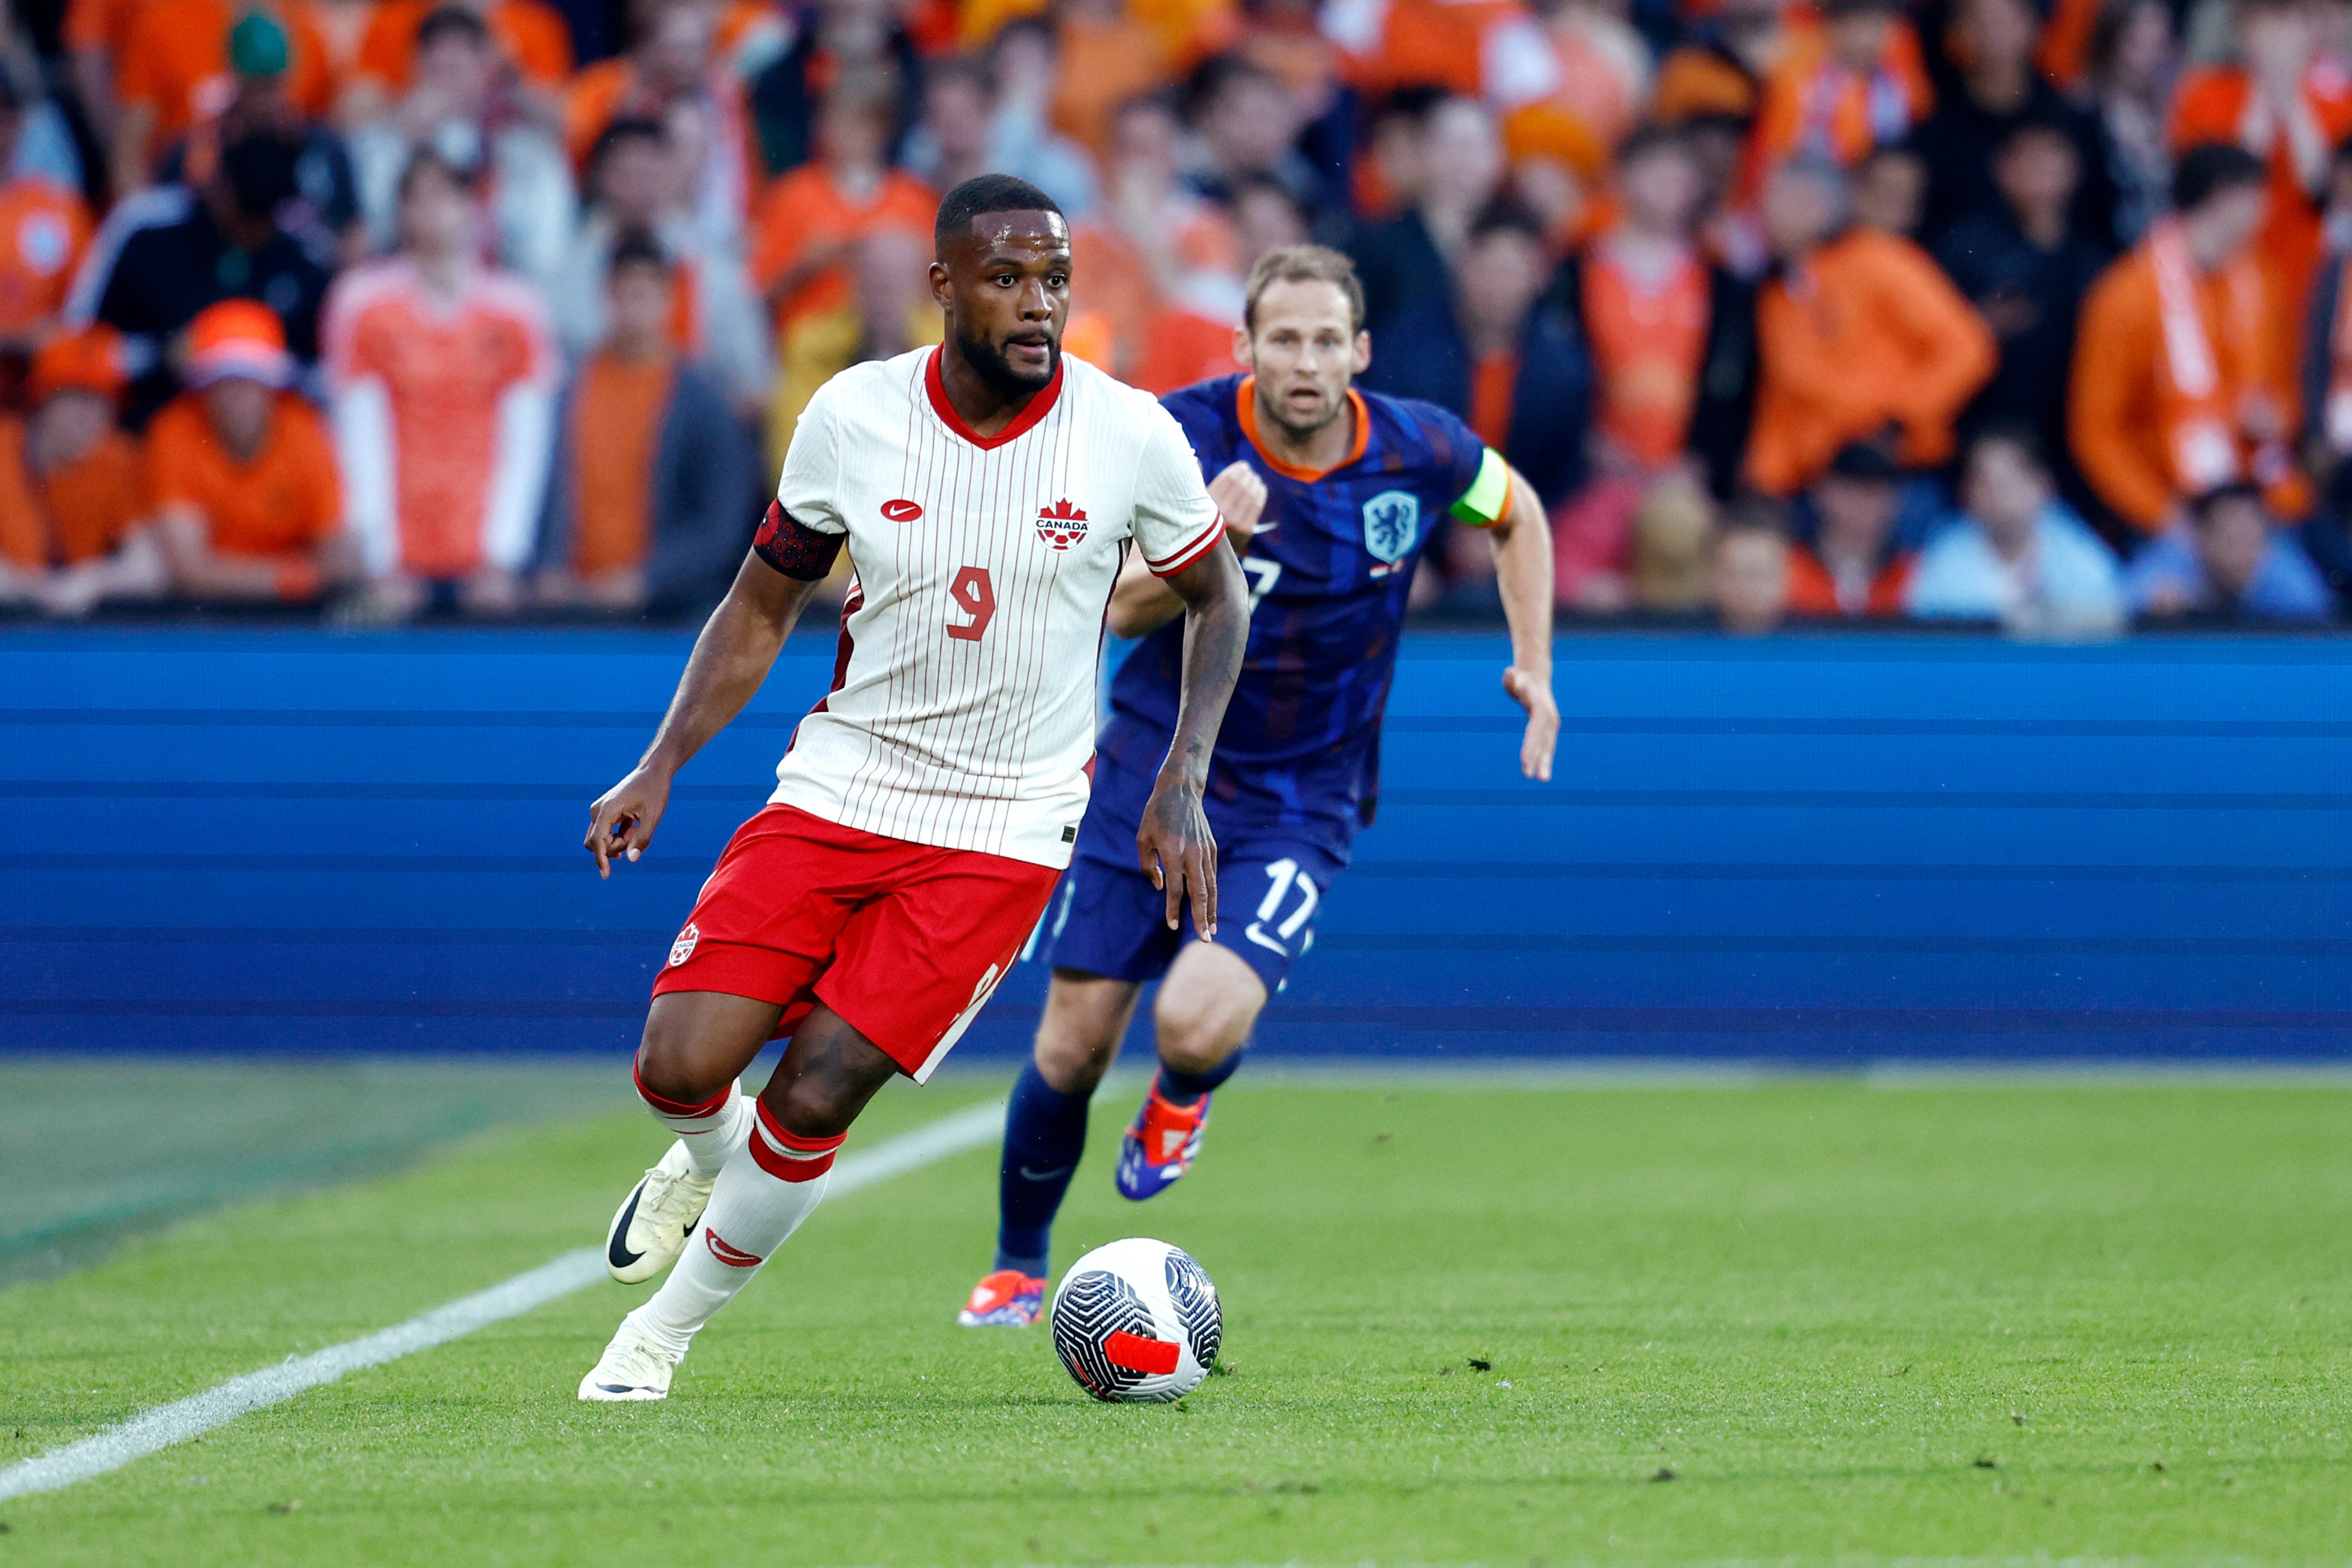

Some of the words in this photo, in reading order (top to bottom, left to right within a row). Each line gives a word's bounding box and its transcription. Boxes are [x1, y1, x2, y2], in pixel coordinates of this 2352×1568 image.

[1036, 520, 1088, 531] CANADA
[946, 566, 995, 641] 9
[1257, 858, 1318, 940] 17
